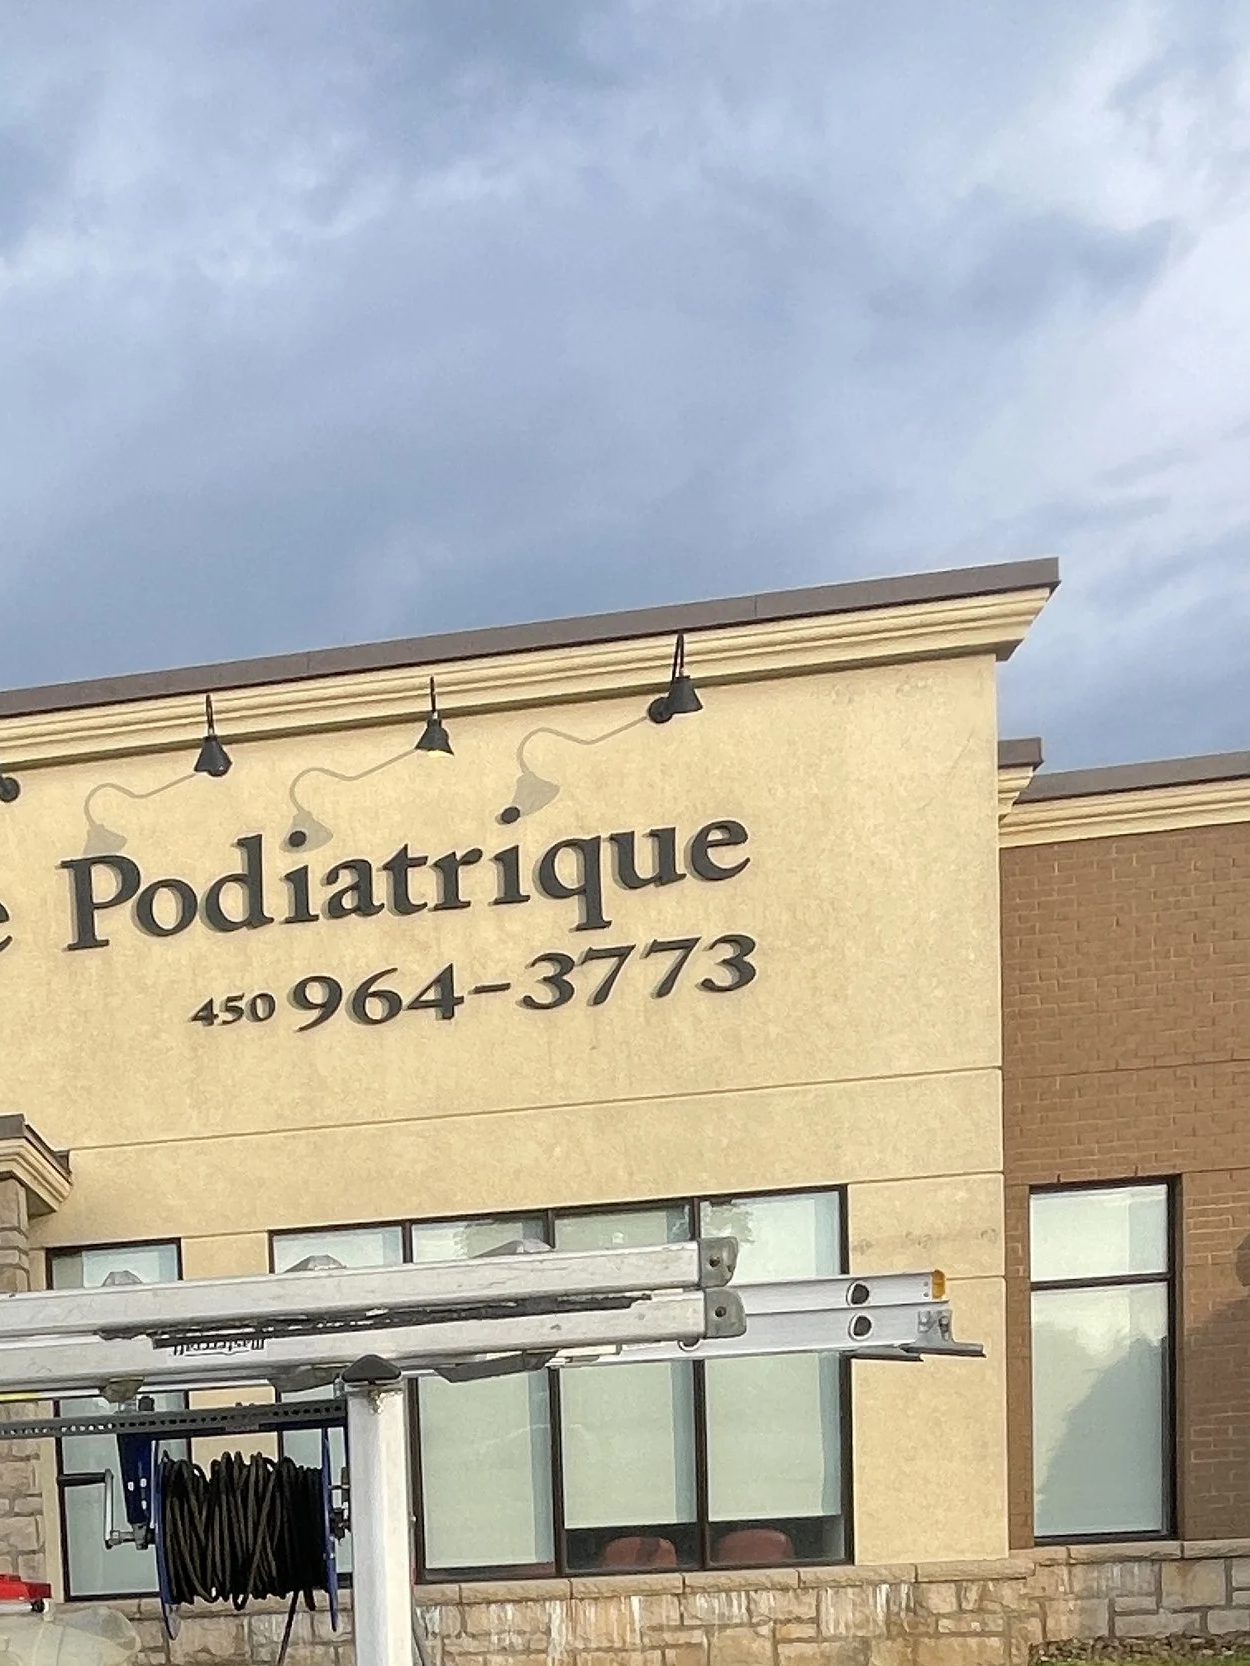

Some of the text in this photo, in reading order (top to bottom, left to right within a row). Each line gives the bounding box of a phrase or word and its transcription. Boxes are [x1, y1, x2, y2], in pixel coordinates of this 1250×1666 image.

[60, 806, 751, 951] Podiatrique
[188, 934, 756, 1033] 450 964-3773
